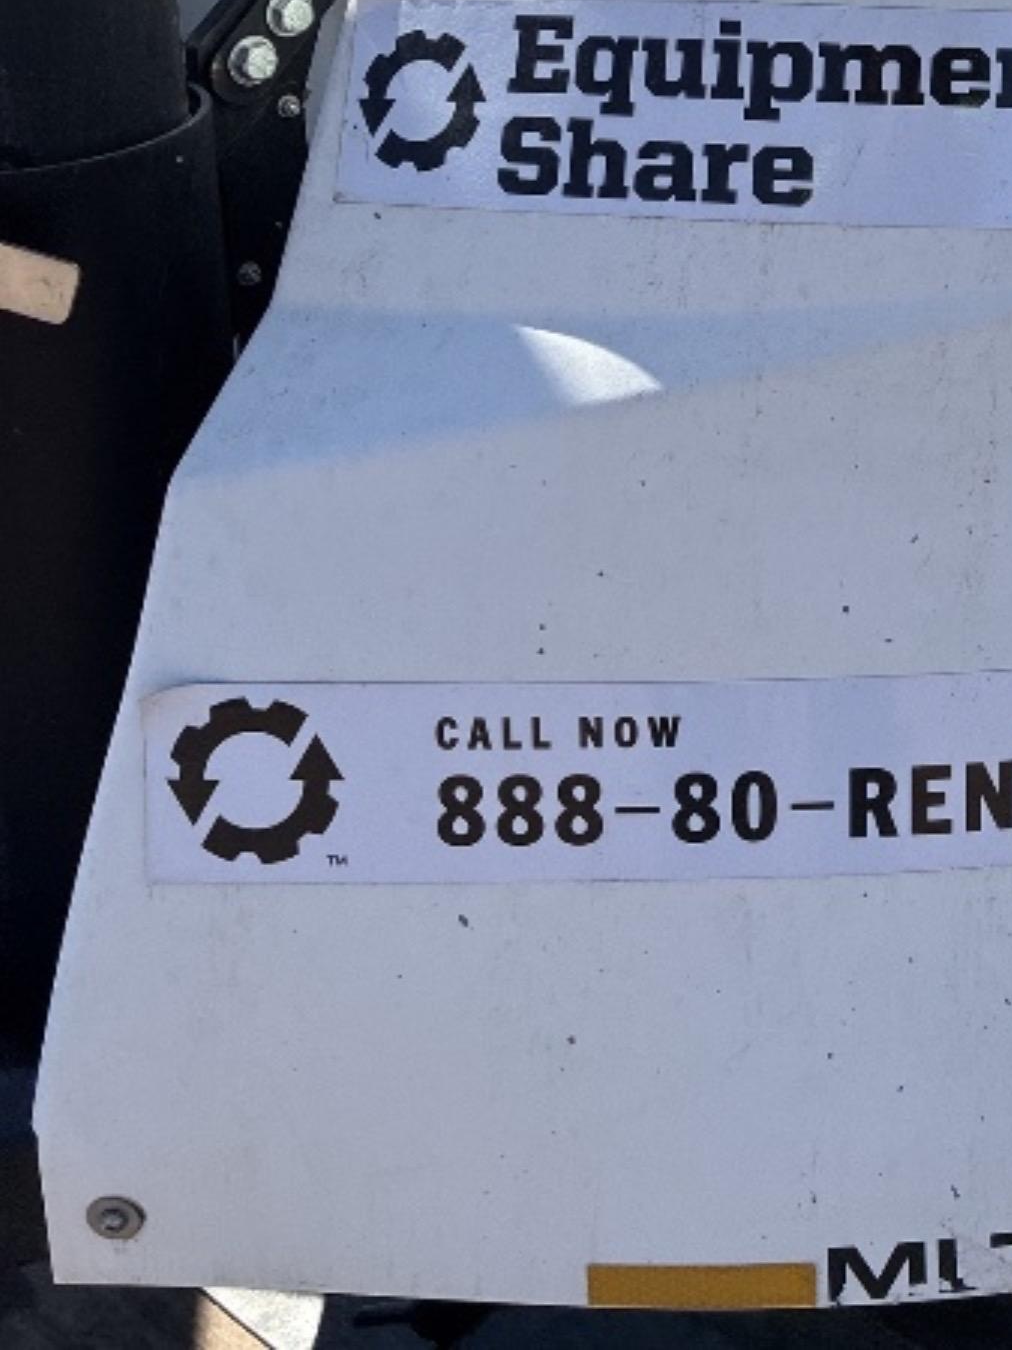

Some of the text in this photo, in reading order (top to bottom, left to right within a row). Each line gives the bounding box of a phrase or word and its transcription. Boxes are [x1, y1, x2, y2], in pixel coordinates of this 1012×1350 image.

[496, 115, 815, 208] Share
[434, 713, 682, 751] CALL NOW
